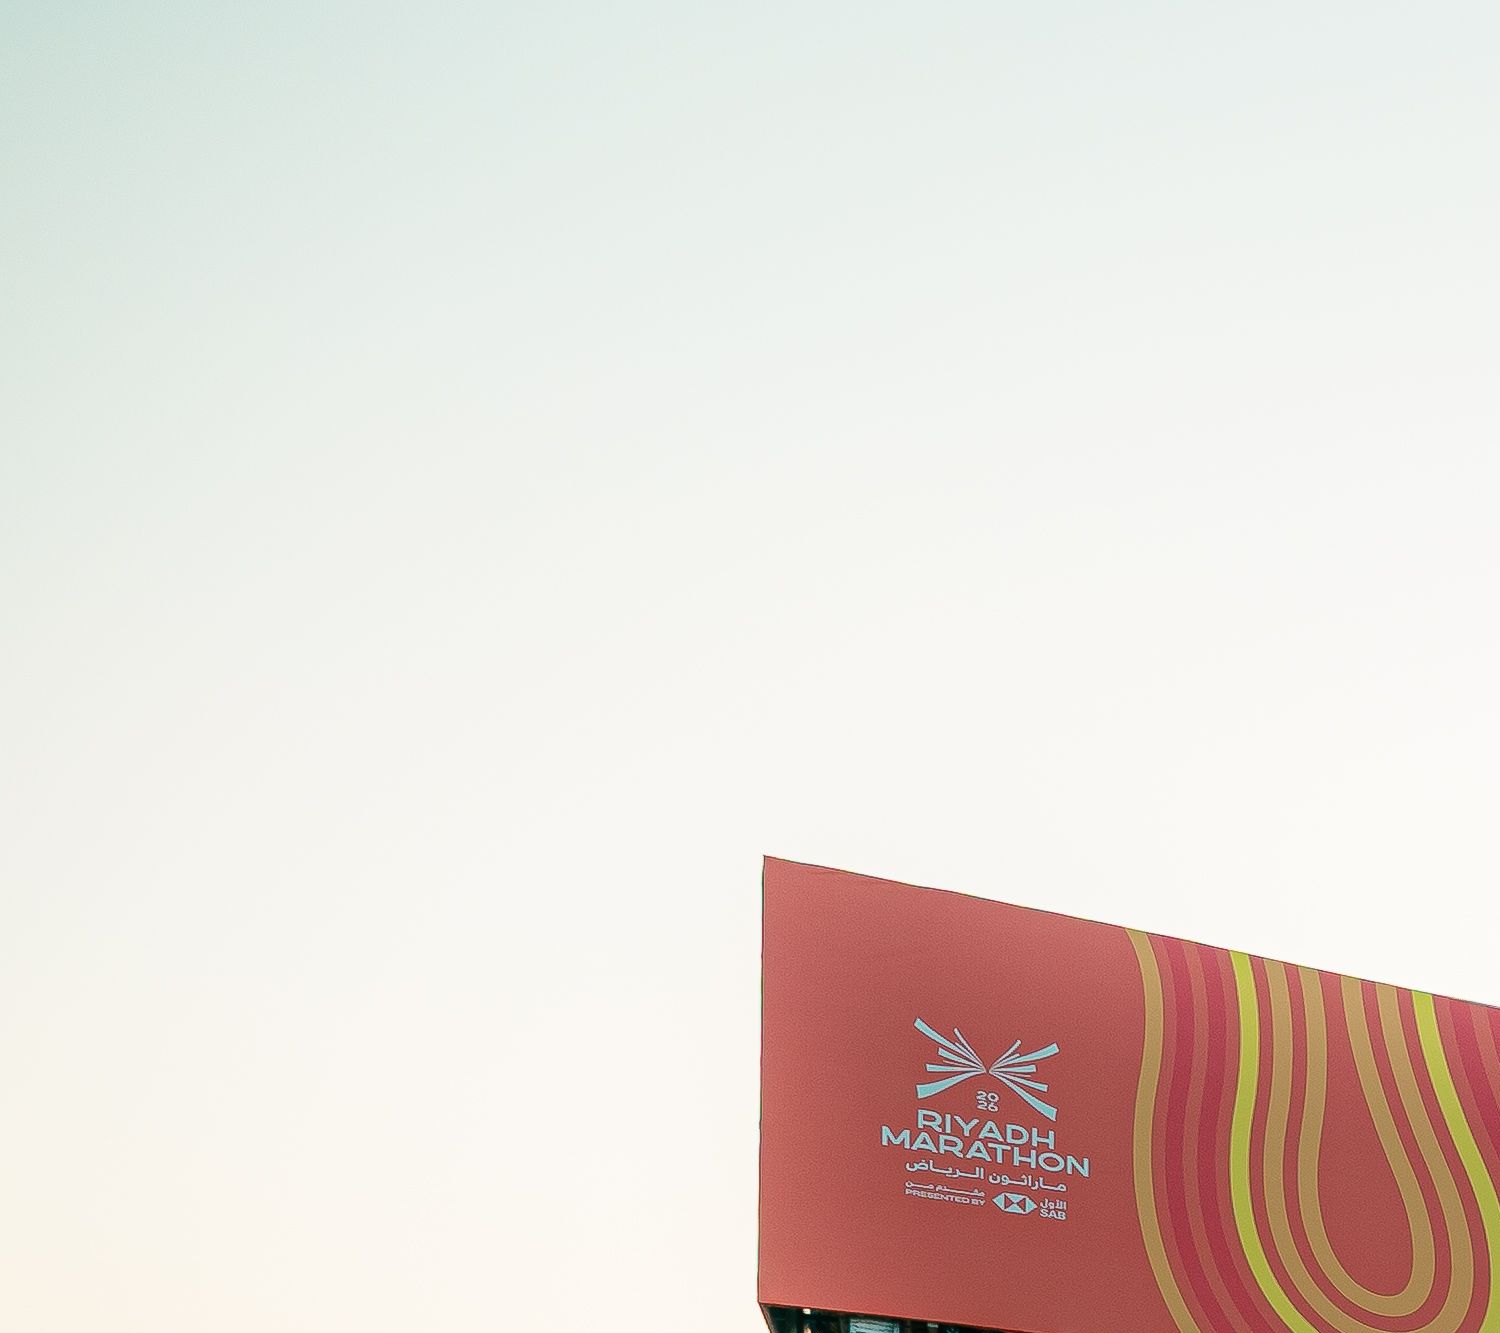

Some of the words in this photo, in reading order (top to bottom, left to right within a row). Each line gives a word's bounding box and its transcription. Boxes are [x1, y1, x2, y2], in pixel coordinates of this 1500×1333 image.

[976, 1091, 999, 1102] 20
[976, 1101, 999, 1112] 26
[917, 1109, 1055, 1150] RIYADH
[881, 1125, 1090, 1177] MARATHON
[905, 1159, 985, 1180] الرياض
[988, 1172, 1067, 1192] ماراثون
[905, 1189, 970, 1204] PRESENTED
[971, 1197, 986, 1206] BY
[1039, 1209, 1067, 1221] SAB
